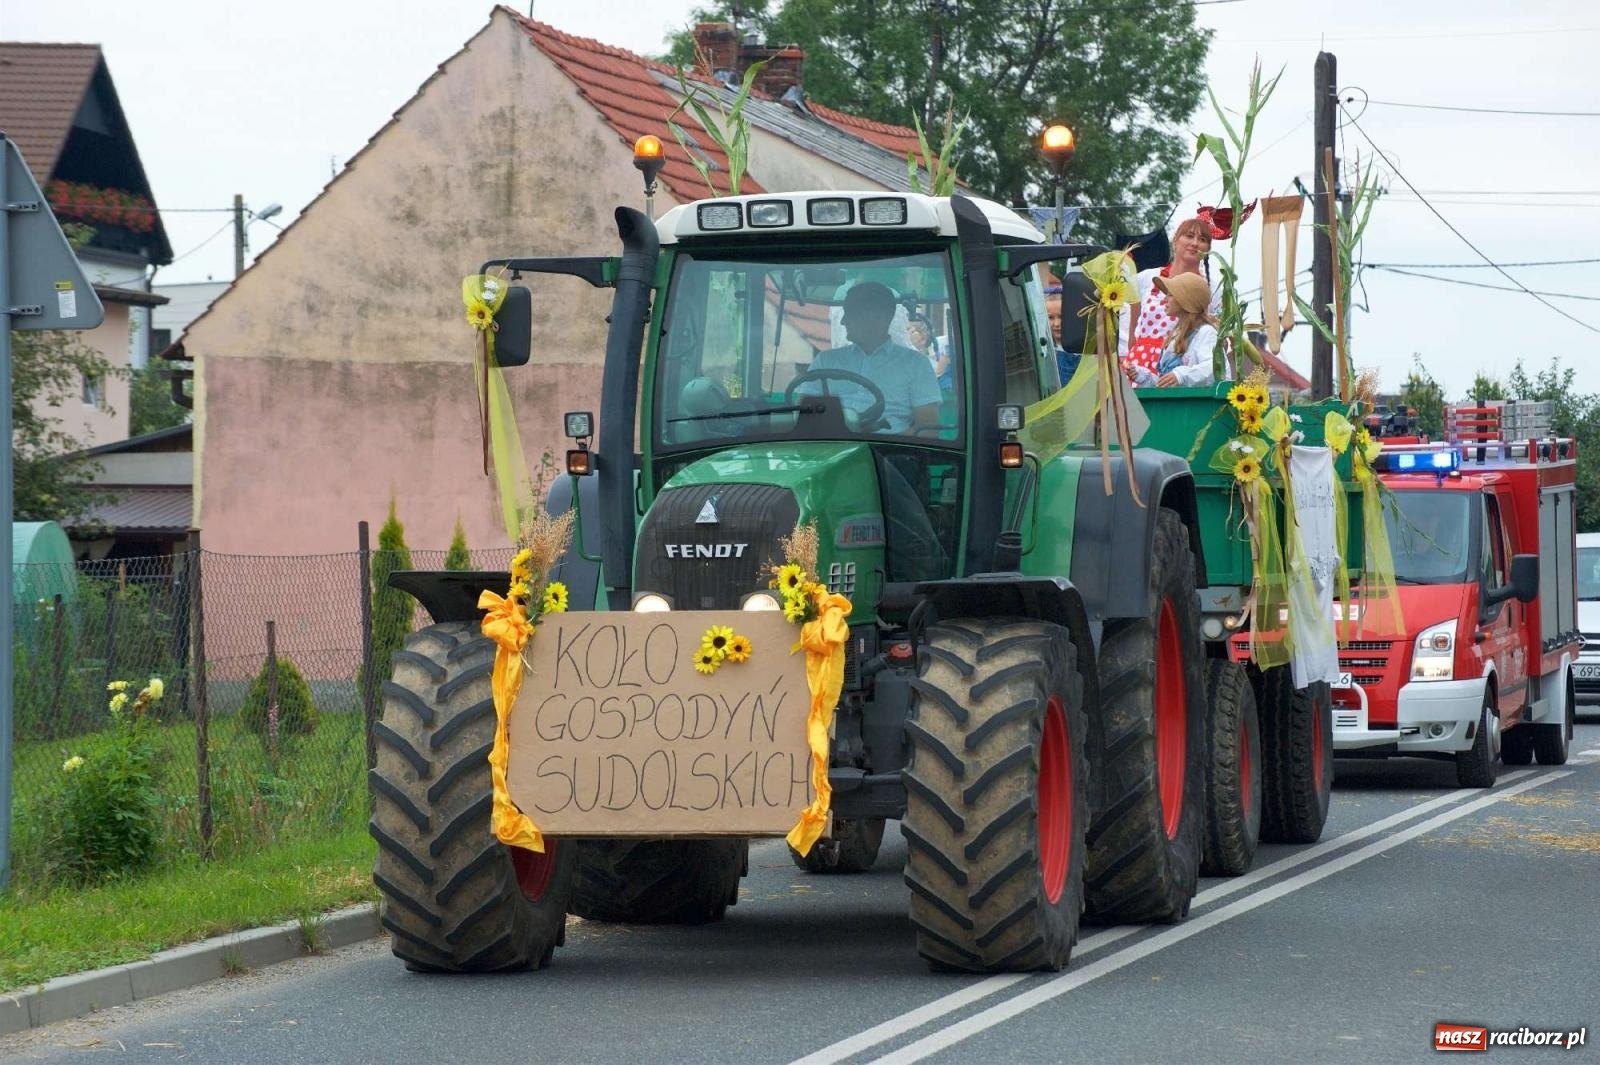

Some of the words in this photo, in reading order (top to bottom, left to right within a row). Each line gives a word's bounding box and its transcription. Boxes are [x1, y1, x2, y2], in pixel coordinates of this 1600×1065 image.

[665, 543, 748, 559] FENDT
[554, 623, 679, 689] KOŁO
[535, 675, 788, 742] GOSPODYŃ
[535, 750, 813, 813] SUDOLSKICH
